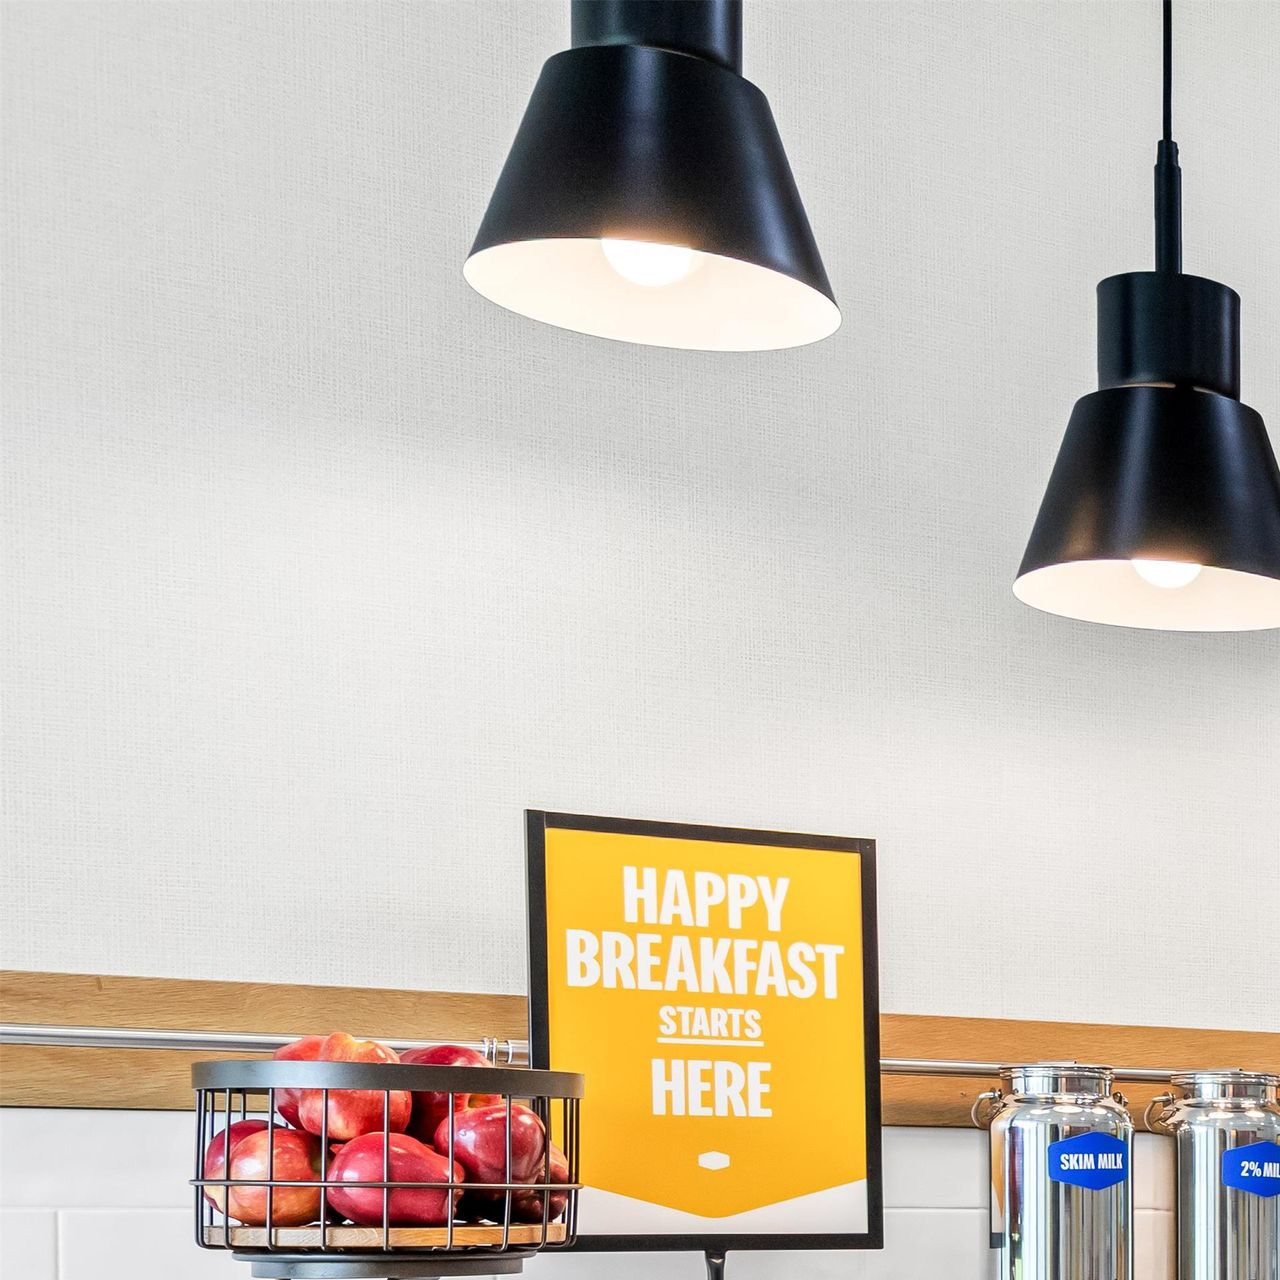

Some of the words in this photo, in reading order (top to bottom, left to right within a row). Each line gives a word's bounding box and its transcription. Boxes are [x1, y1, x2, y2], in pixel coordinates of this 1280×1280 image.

[622, 865, 790, 932] HAPPY
[565, 928, 845, 999] BREAKFAST
[658, 1005, 763, 1039] STARTS
[651, 1058, 773, 1118] HERE
[1060, 1153, 1096, 1171] SKIM
[1097, 1153, 1123, 1170] MILK
[1240, 1160, 1262, 1178] 2%
